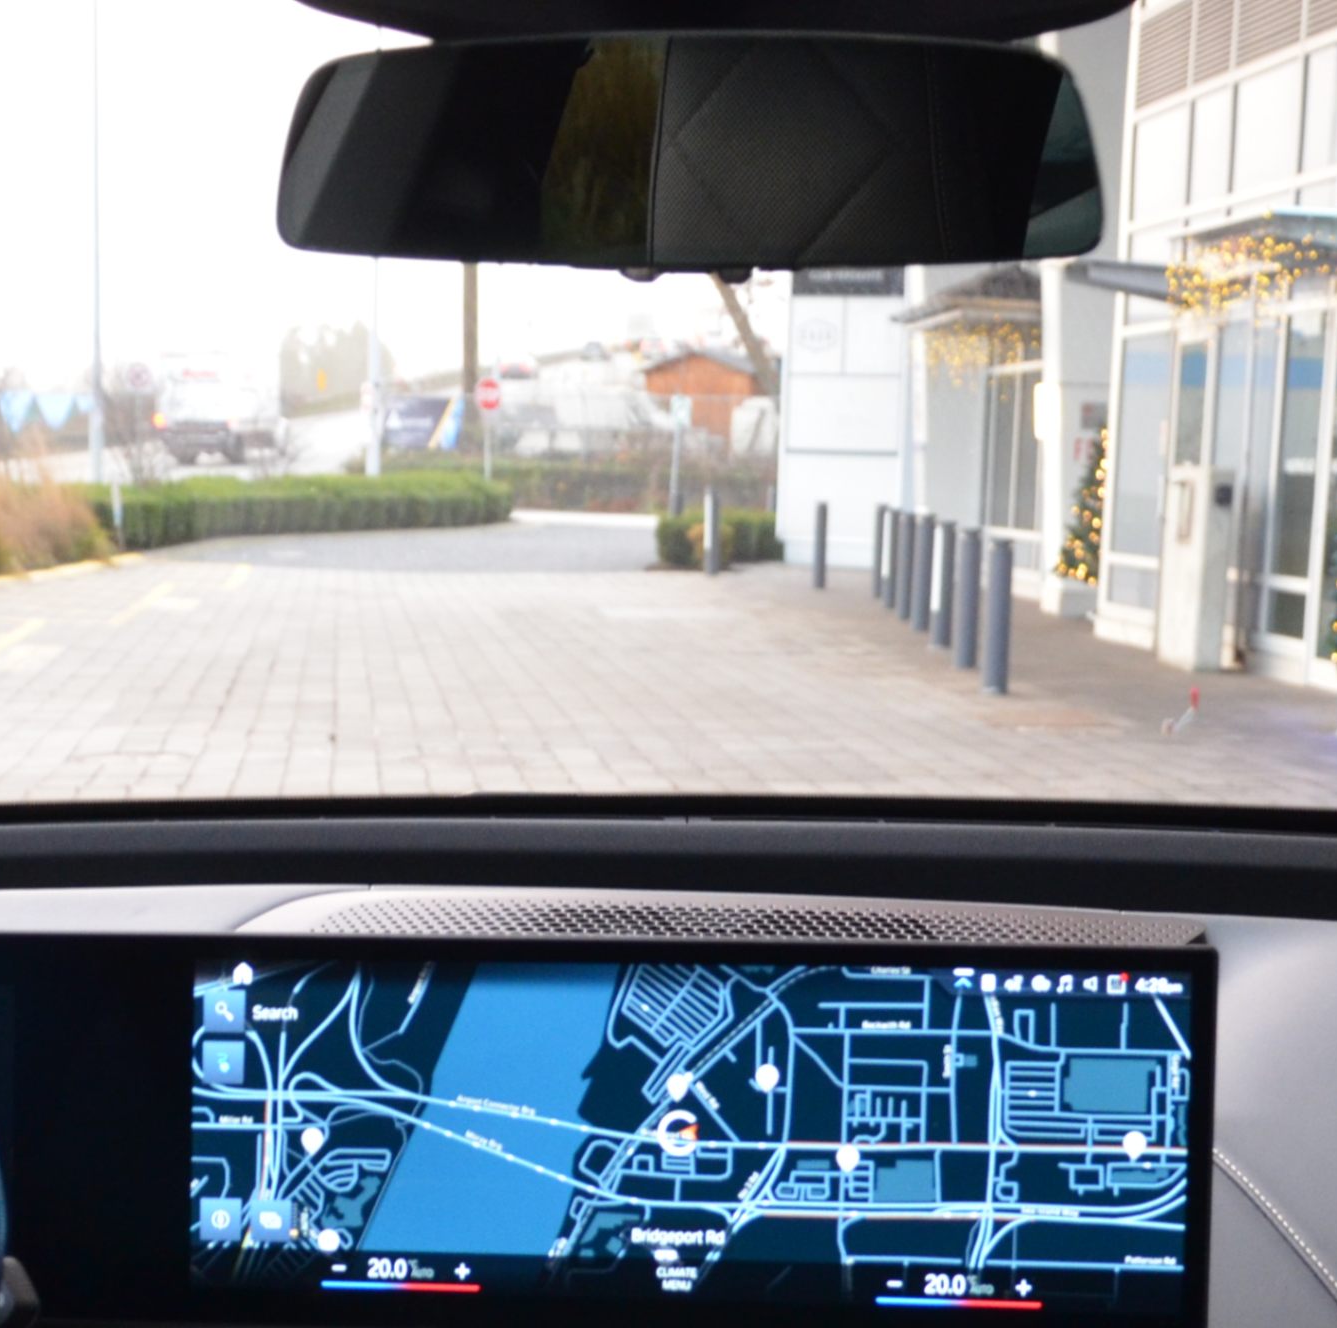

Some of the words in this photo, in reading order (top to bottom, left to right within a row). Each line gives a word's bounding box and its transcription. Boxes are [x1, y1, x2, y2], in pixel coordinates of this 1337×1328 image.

[252, 1004, 298, 1021] Search
[631, 1227, 703, 1245] Bridgeport
[705, 1229, 726, 1245] Rd
[367, 1258, 407, 1279] 20.0
[656, 1267, 698, 1279] CLIMATE
[662, 1280, 692, 1292] MENU
[924, 1274, 966, 1296] 20.0
